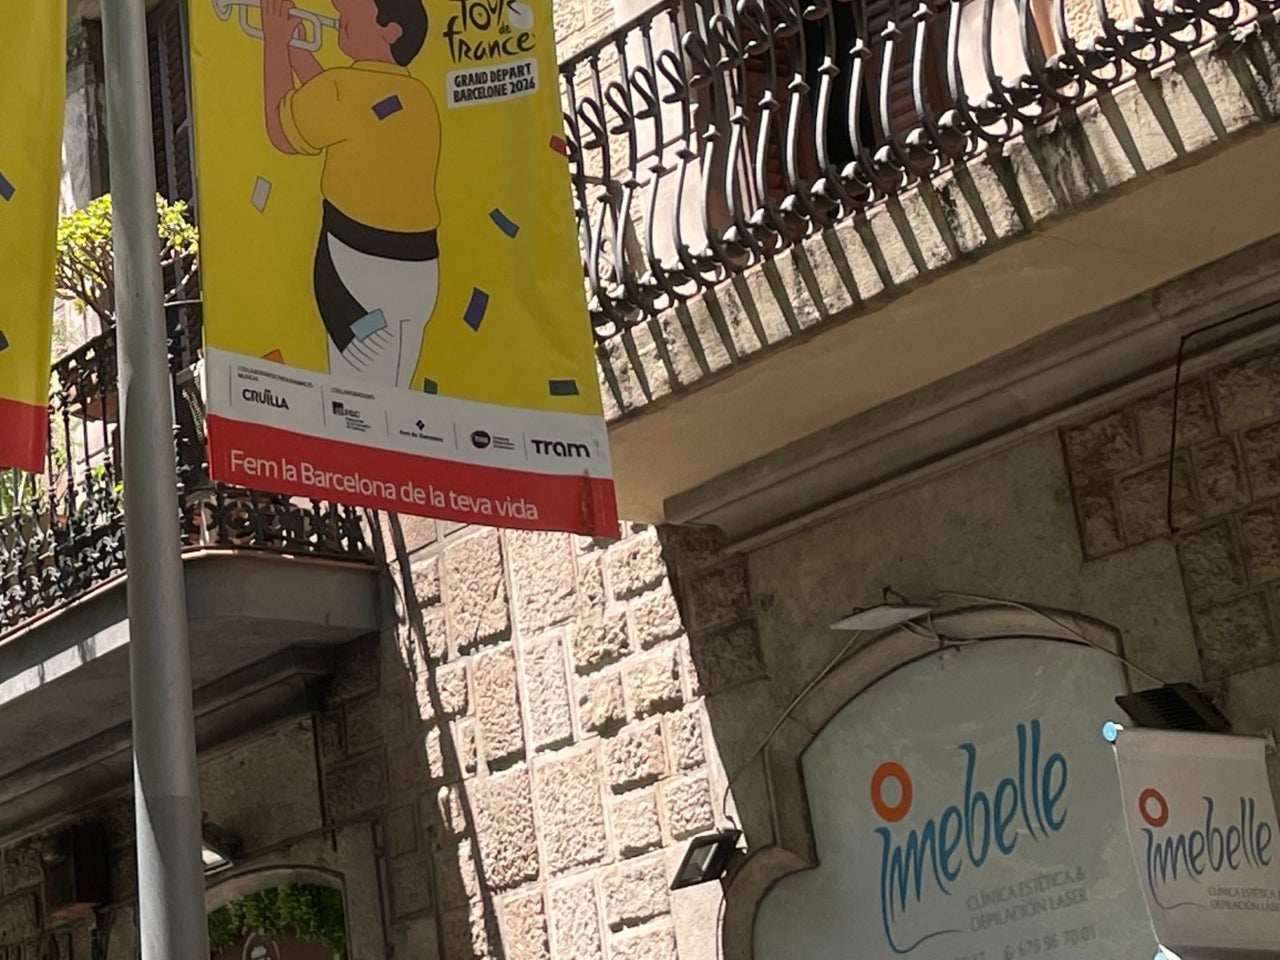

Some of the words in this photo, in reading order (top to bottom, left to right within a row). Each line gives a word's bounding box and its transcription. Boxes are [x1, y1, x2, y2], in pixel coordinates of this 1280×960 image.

[453, 83, 507, 103] BARCELONE
[510, 77, 536, 94] 2026
[454, 71, 488, 88] GRAND
[230, 448, 279, 480] Fem
[282, 457, 298, 483] la
[301, 463, 397, 501] Barcelona
[400, 479, 426, 505] de
[429, 483, 445, 508] la
[449, 489, 493, 515] teva
[495, 493, 539, 520] vida
